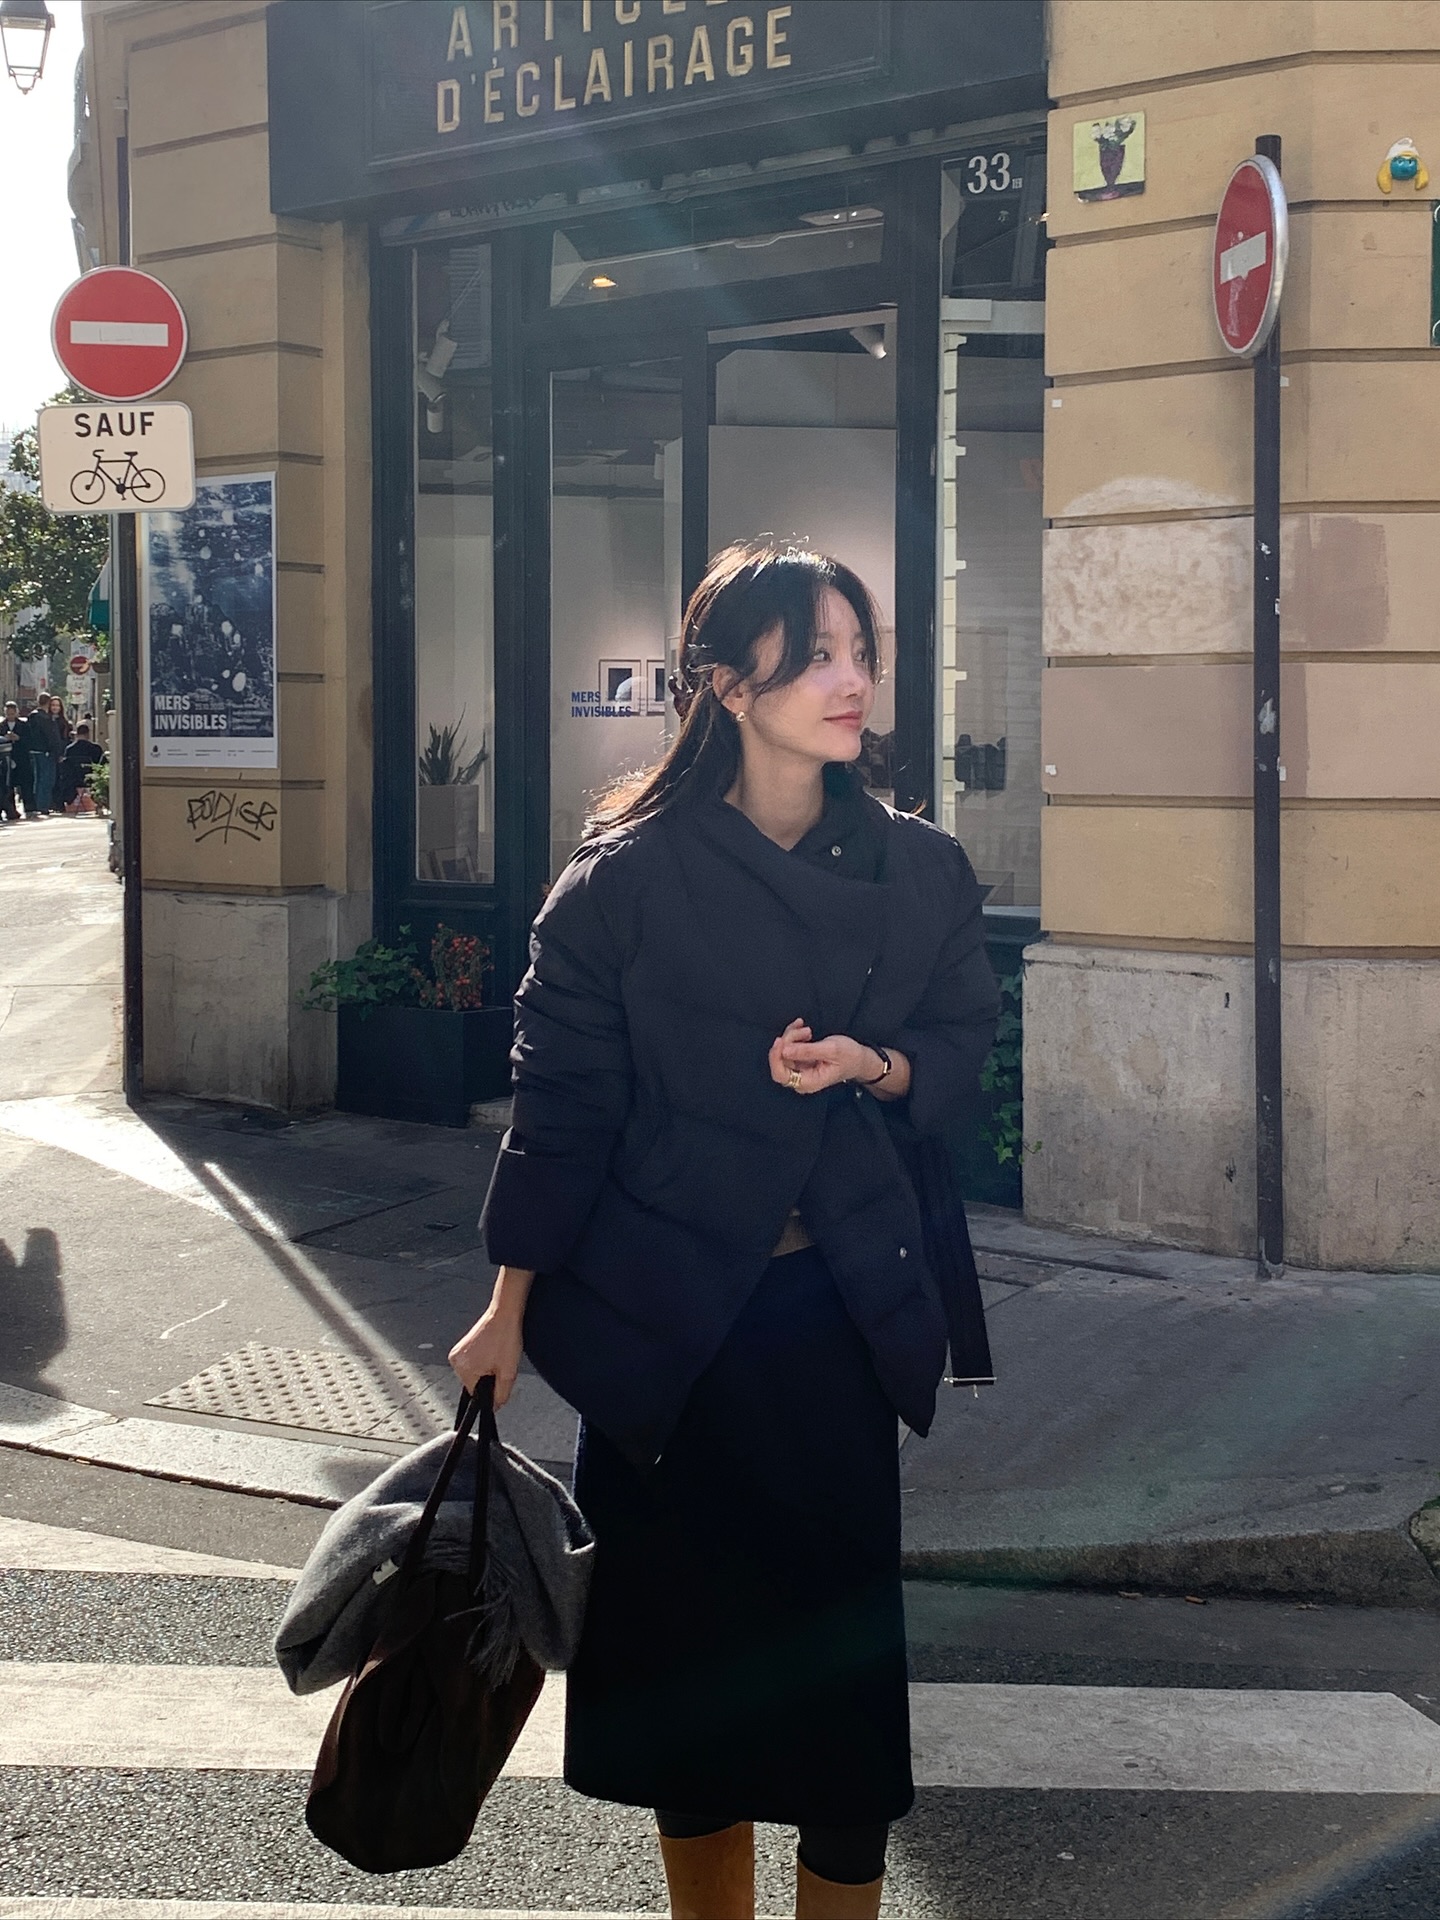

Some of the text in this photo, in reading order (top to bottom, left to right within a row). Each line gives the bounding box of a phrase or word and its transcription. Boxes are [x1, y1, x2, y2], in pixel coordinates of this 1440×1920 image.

[437, 6, 791, 133] D'ÉCLAIRAGE
[967, 152, 1011, 194] 33
[74, 411, 154, 438] SAUF
[154, 694, 191, 711] MERS
[571, 691, 601, 703] MERS
[571, 706, 632, 718] INVISIBLES
[154, 714, 227, 730] INVISIBLES
